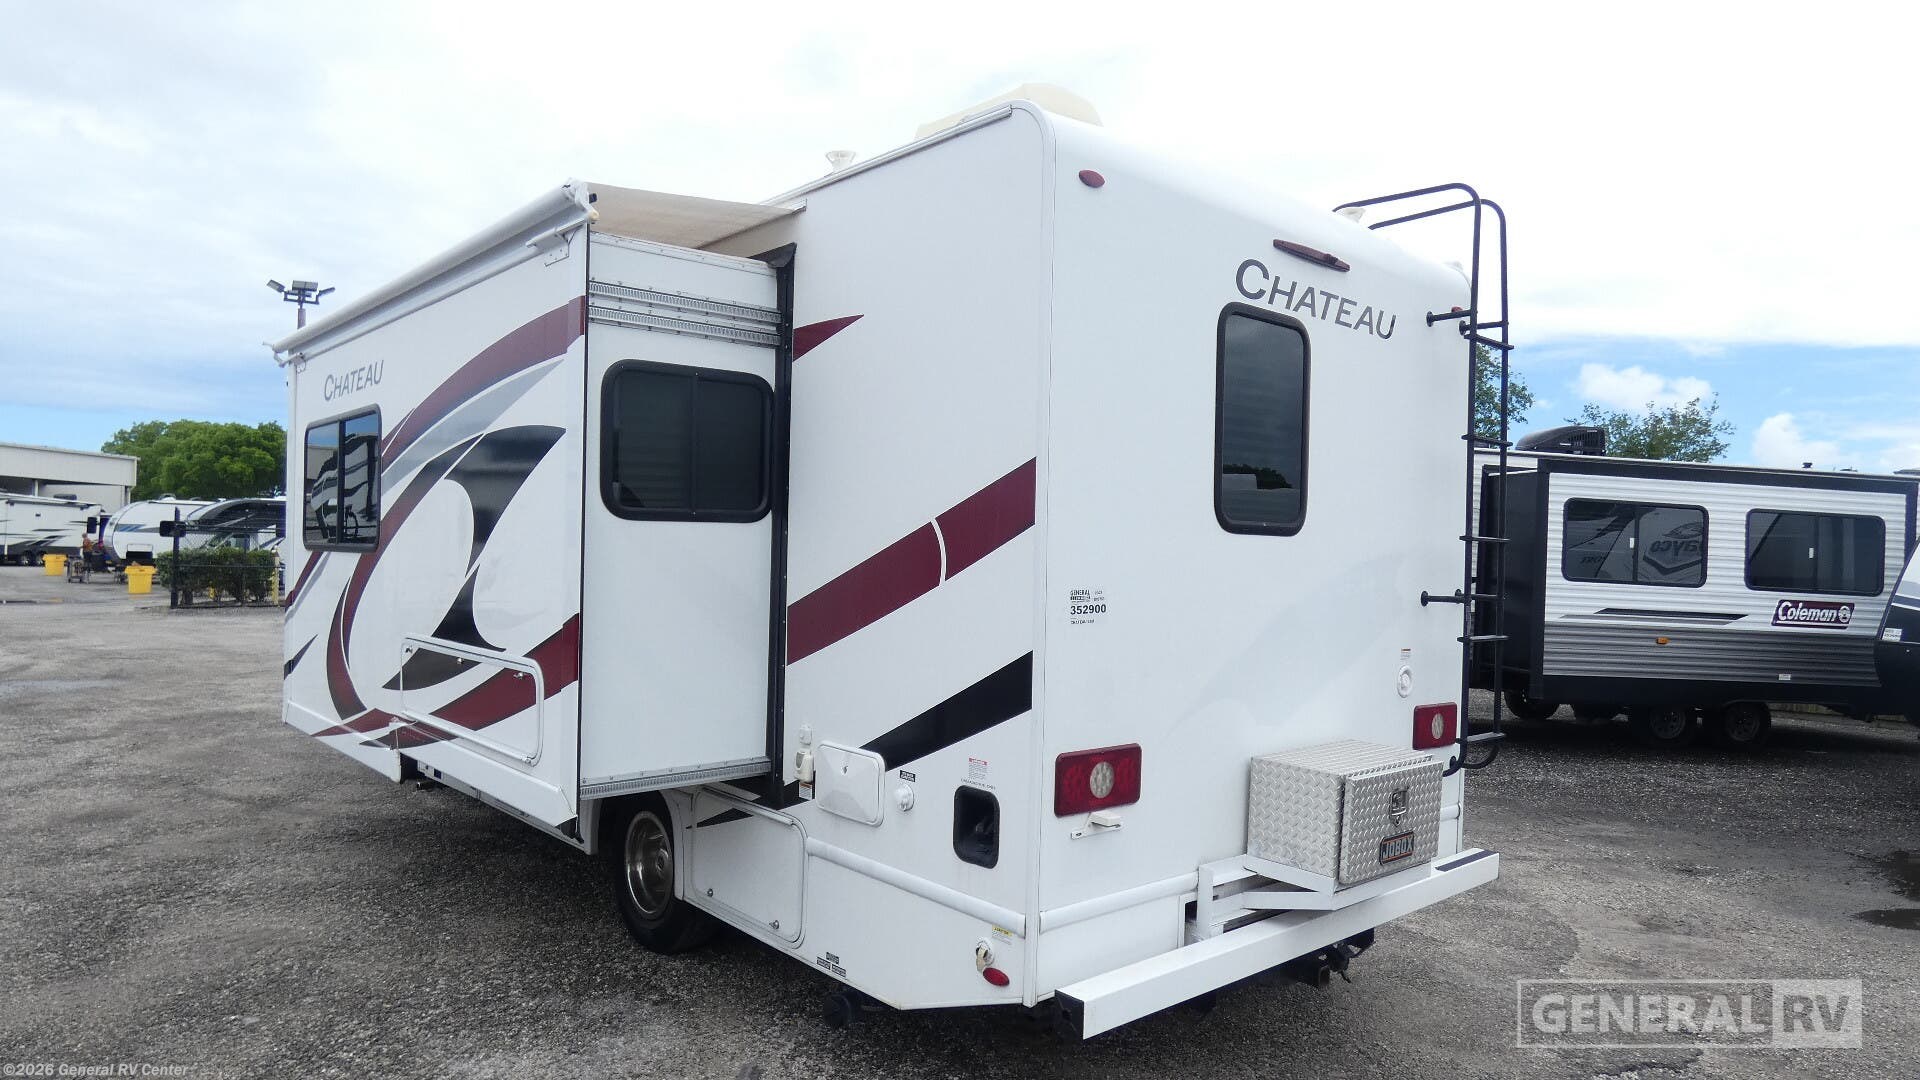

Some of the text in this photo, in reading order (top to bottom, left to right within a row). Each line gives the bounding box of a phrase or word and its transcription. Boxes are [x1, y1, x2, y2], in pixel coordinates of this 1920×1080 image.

[1236, 258, 1396, 339] CHATEAU
[324, 359, 384, 401] CHATEAU
[1070, 604, 1107, 615] 352900
[1778, 601, 1837, 622] Coleman
[1383, 835, 1413, 858] JOBOX
